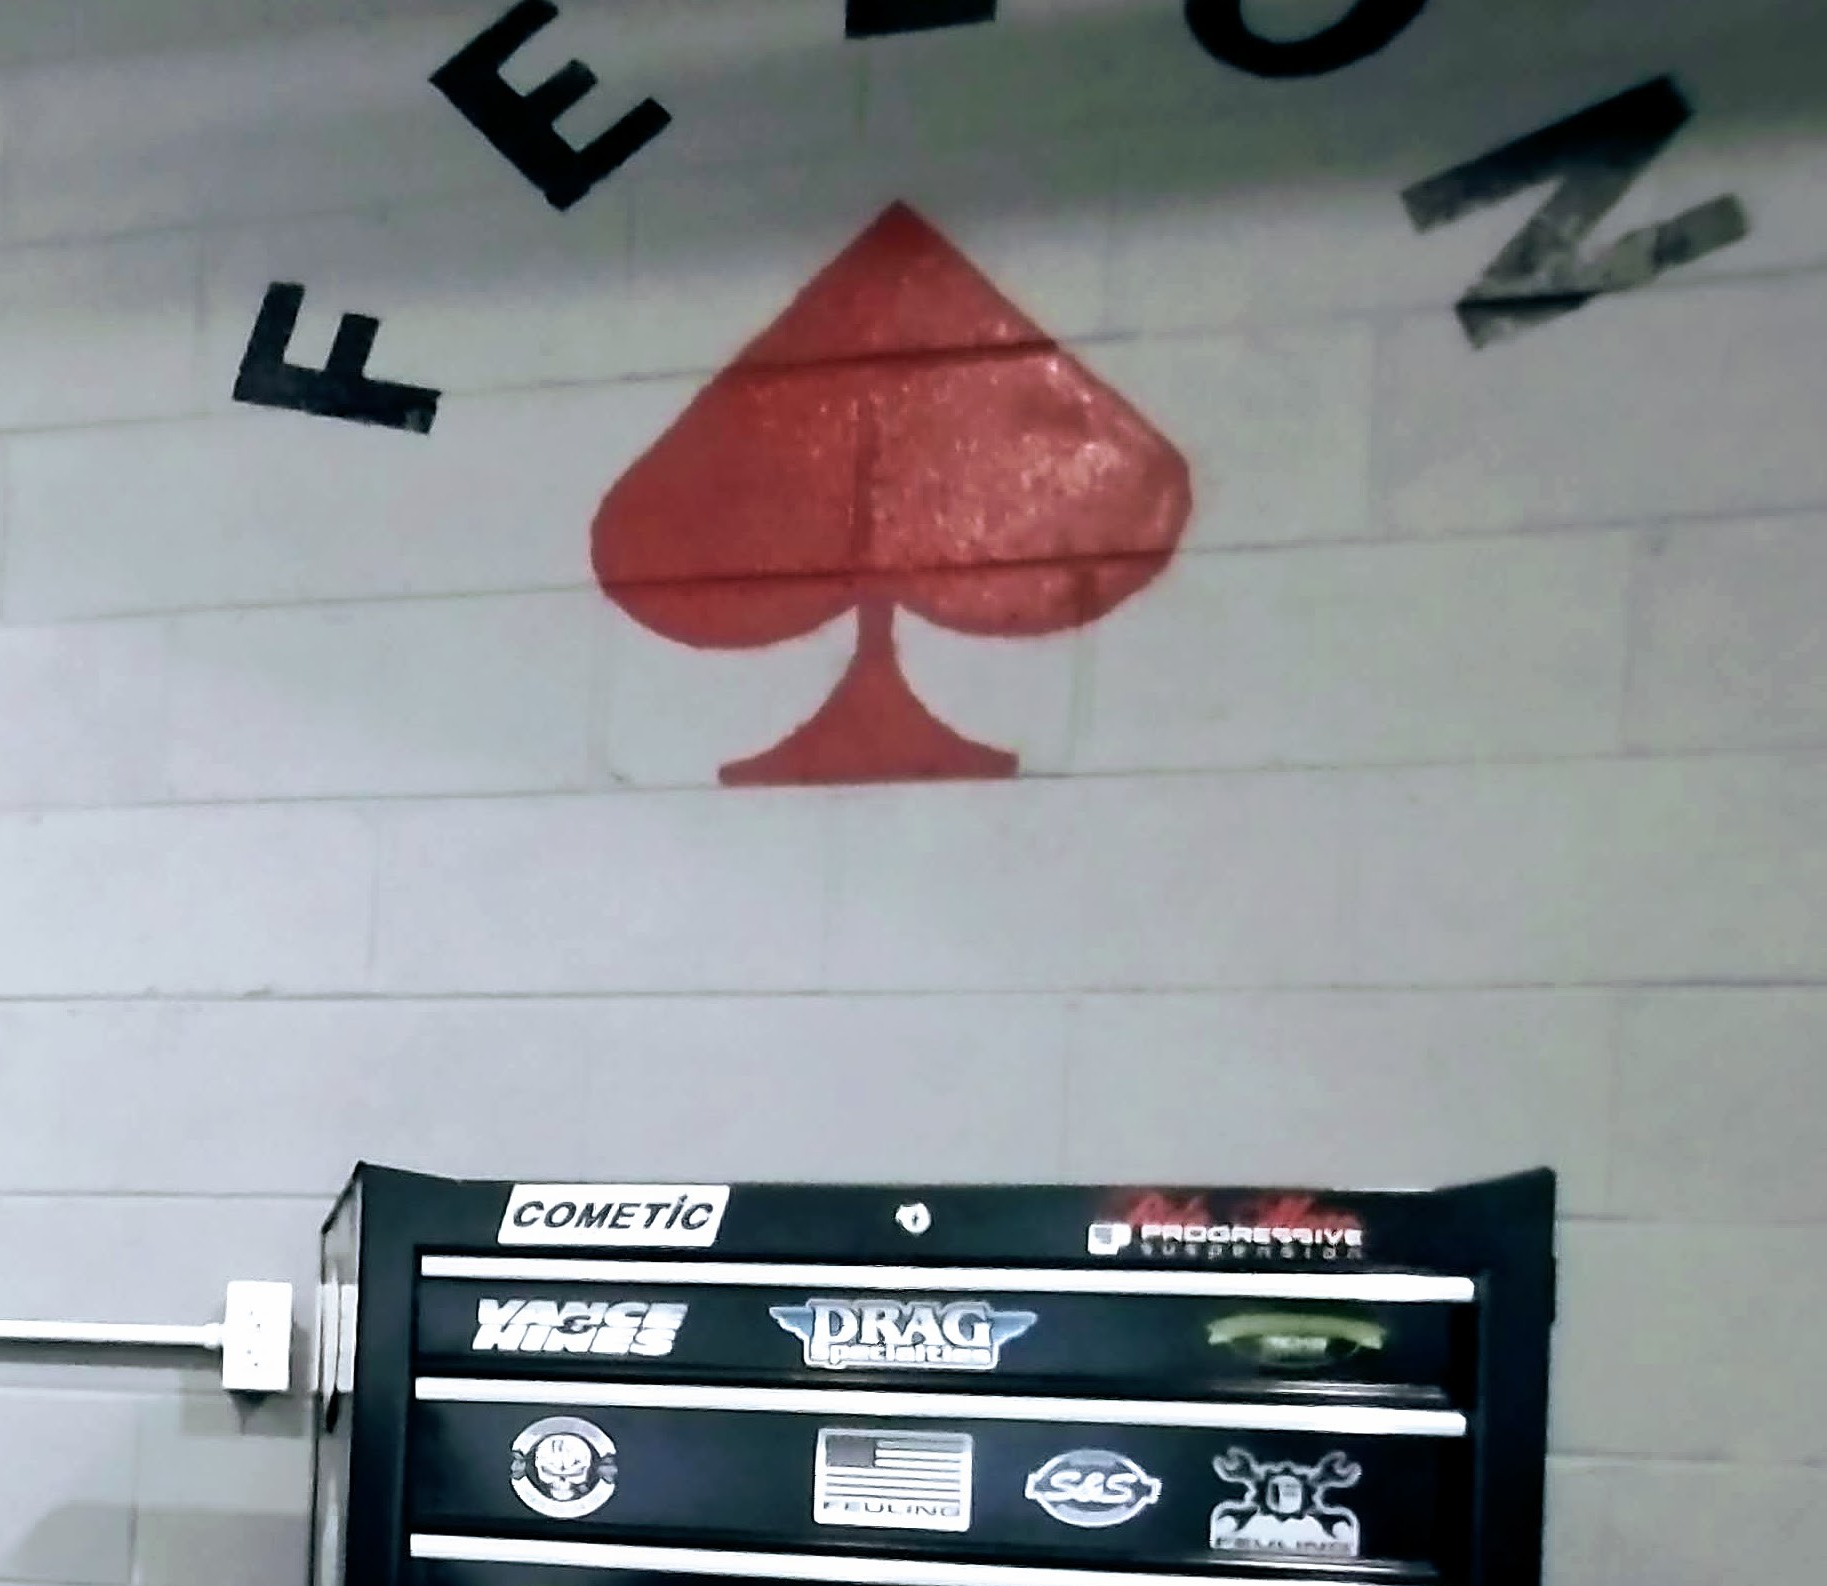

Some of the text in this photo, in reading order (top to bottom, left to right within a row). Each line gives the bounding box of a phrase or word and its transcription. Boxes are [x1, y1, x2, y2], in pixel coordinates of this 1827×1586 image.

[232, 0, 1751, 435] FEN
[512, 1194, 715, 1231] COMETIC
[1140, 1223, 1364, 1247] PROGRESSIVE
[478, 1299, 689, 1332] VANCE
[811, 1303, 992, 1350] DRAG
[472, 1324, 677, 1357] HINES
[1049, 1470, 1138, 1504] S&S
